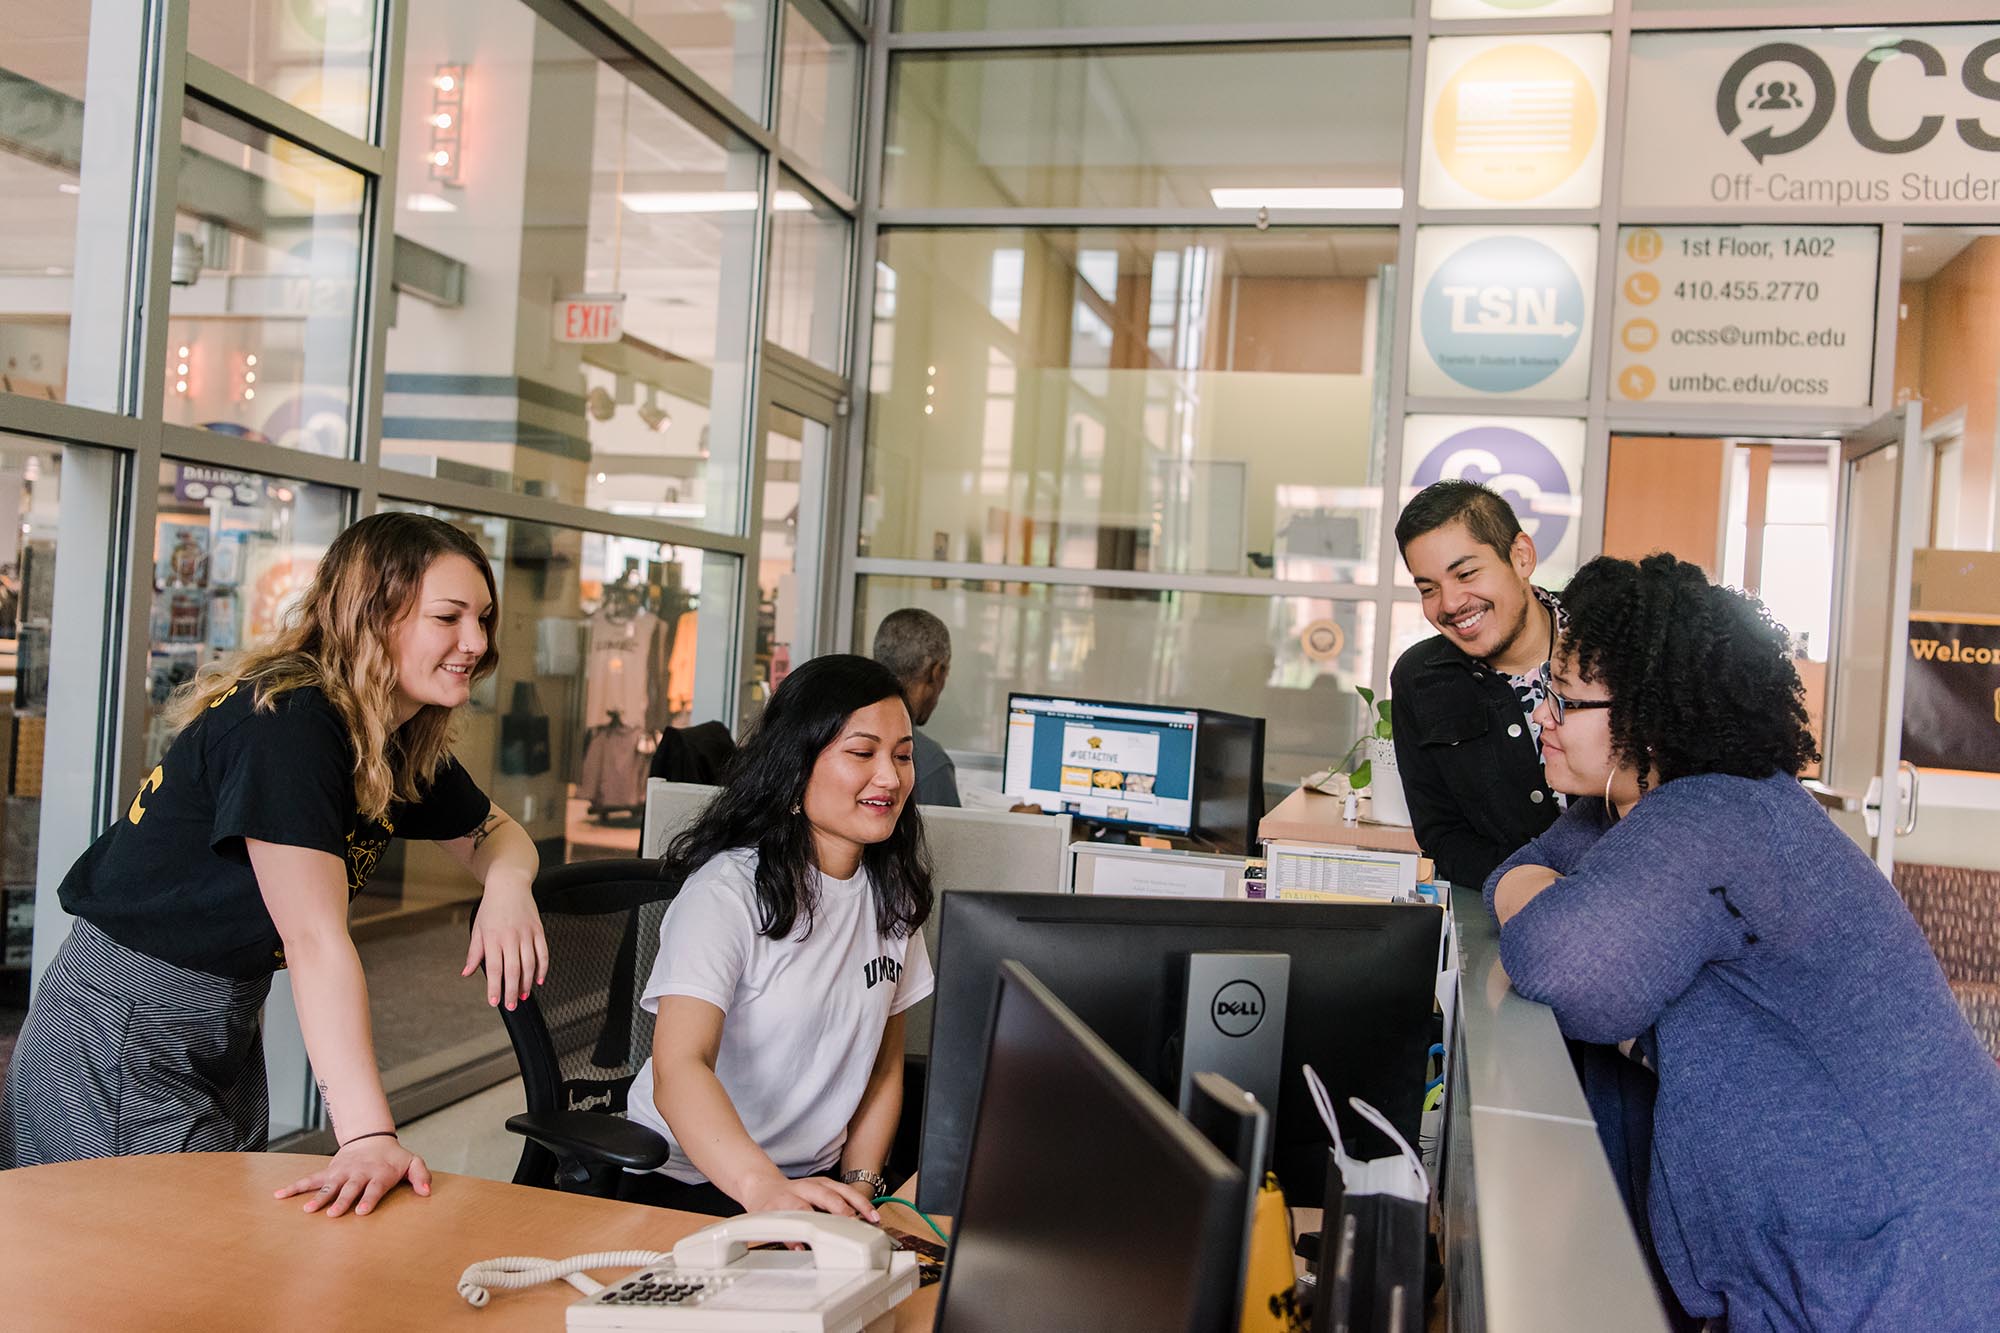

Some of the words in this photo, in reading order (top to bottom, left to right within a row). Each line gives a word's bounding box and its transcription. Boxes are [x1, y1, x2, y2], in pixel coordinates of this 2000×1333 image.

[1710, 172, 1890, 206] Off-Campus
[1681, 238, 1711, 257] 1st
[1718, 237, 1774, 260] Floor,
[1783, 238, 1835, 257] 1A02
[1674, 281, 1819, 301] 410.455.2770
[566, 303, 613, 338] EXIT
[1442, 286, 1558, 332] TSN
[1671, 325, 1846, 347] ocss@umbc.edu
[1668, 372, 1829, 395] umbc.edu/ocss
[1069, 750, 1119, 764] #GETACTIVE
[1217, 1001, 1259, 1016] DELL
